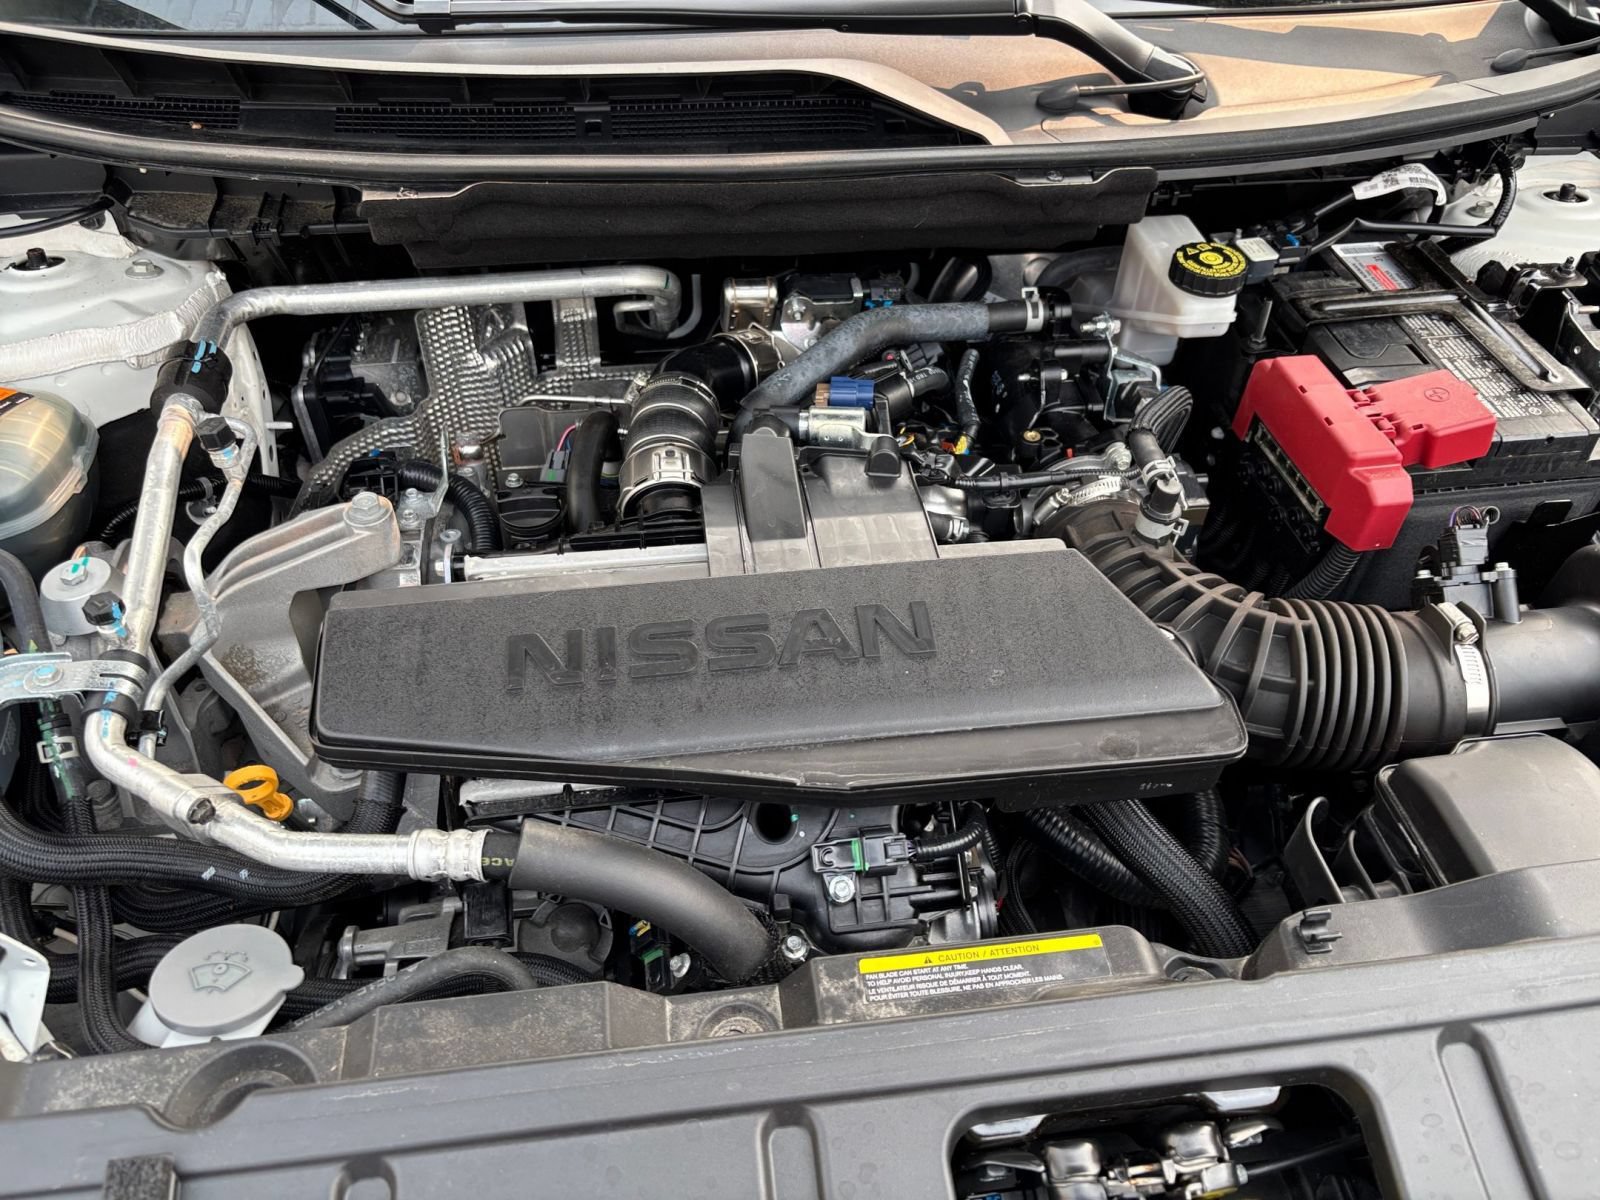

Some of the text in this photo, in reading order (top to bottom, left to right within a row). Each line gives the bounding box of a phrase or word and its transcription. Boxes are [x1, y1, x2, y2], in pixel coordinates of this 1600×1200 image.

[506, 600, 938, 690] NISSAN
[938, 951, 979, 962] CAUTION
[990, 944, 1039, 956] ATTENTION
[877, 983, 915, 994] VENTILATEUR
[916, 981, 939, 989] RISQUE
[949, 976, 982, 986] DÉMARRER
[982, 974, 987, 982] À
[987, 973, 1003, 981] TOUT
[1003, 970, 1031, 979] MOMENT.
[879, 971, 898, 979] BLADE
[913, 967, 931, 975] START
[893, 976, 911, 984] AVOID
[912, 973, 944, 982] PERSONAL
[981, 966, 1002, 974] HANDS
[1002, 963, 1024, 971] CLEAR.
[870, 994, 887, 1002] POUR
[909, 989, 929, 997] TOUTE
[994, 978, 1031, 987] APPROCHER
